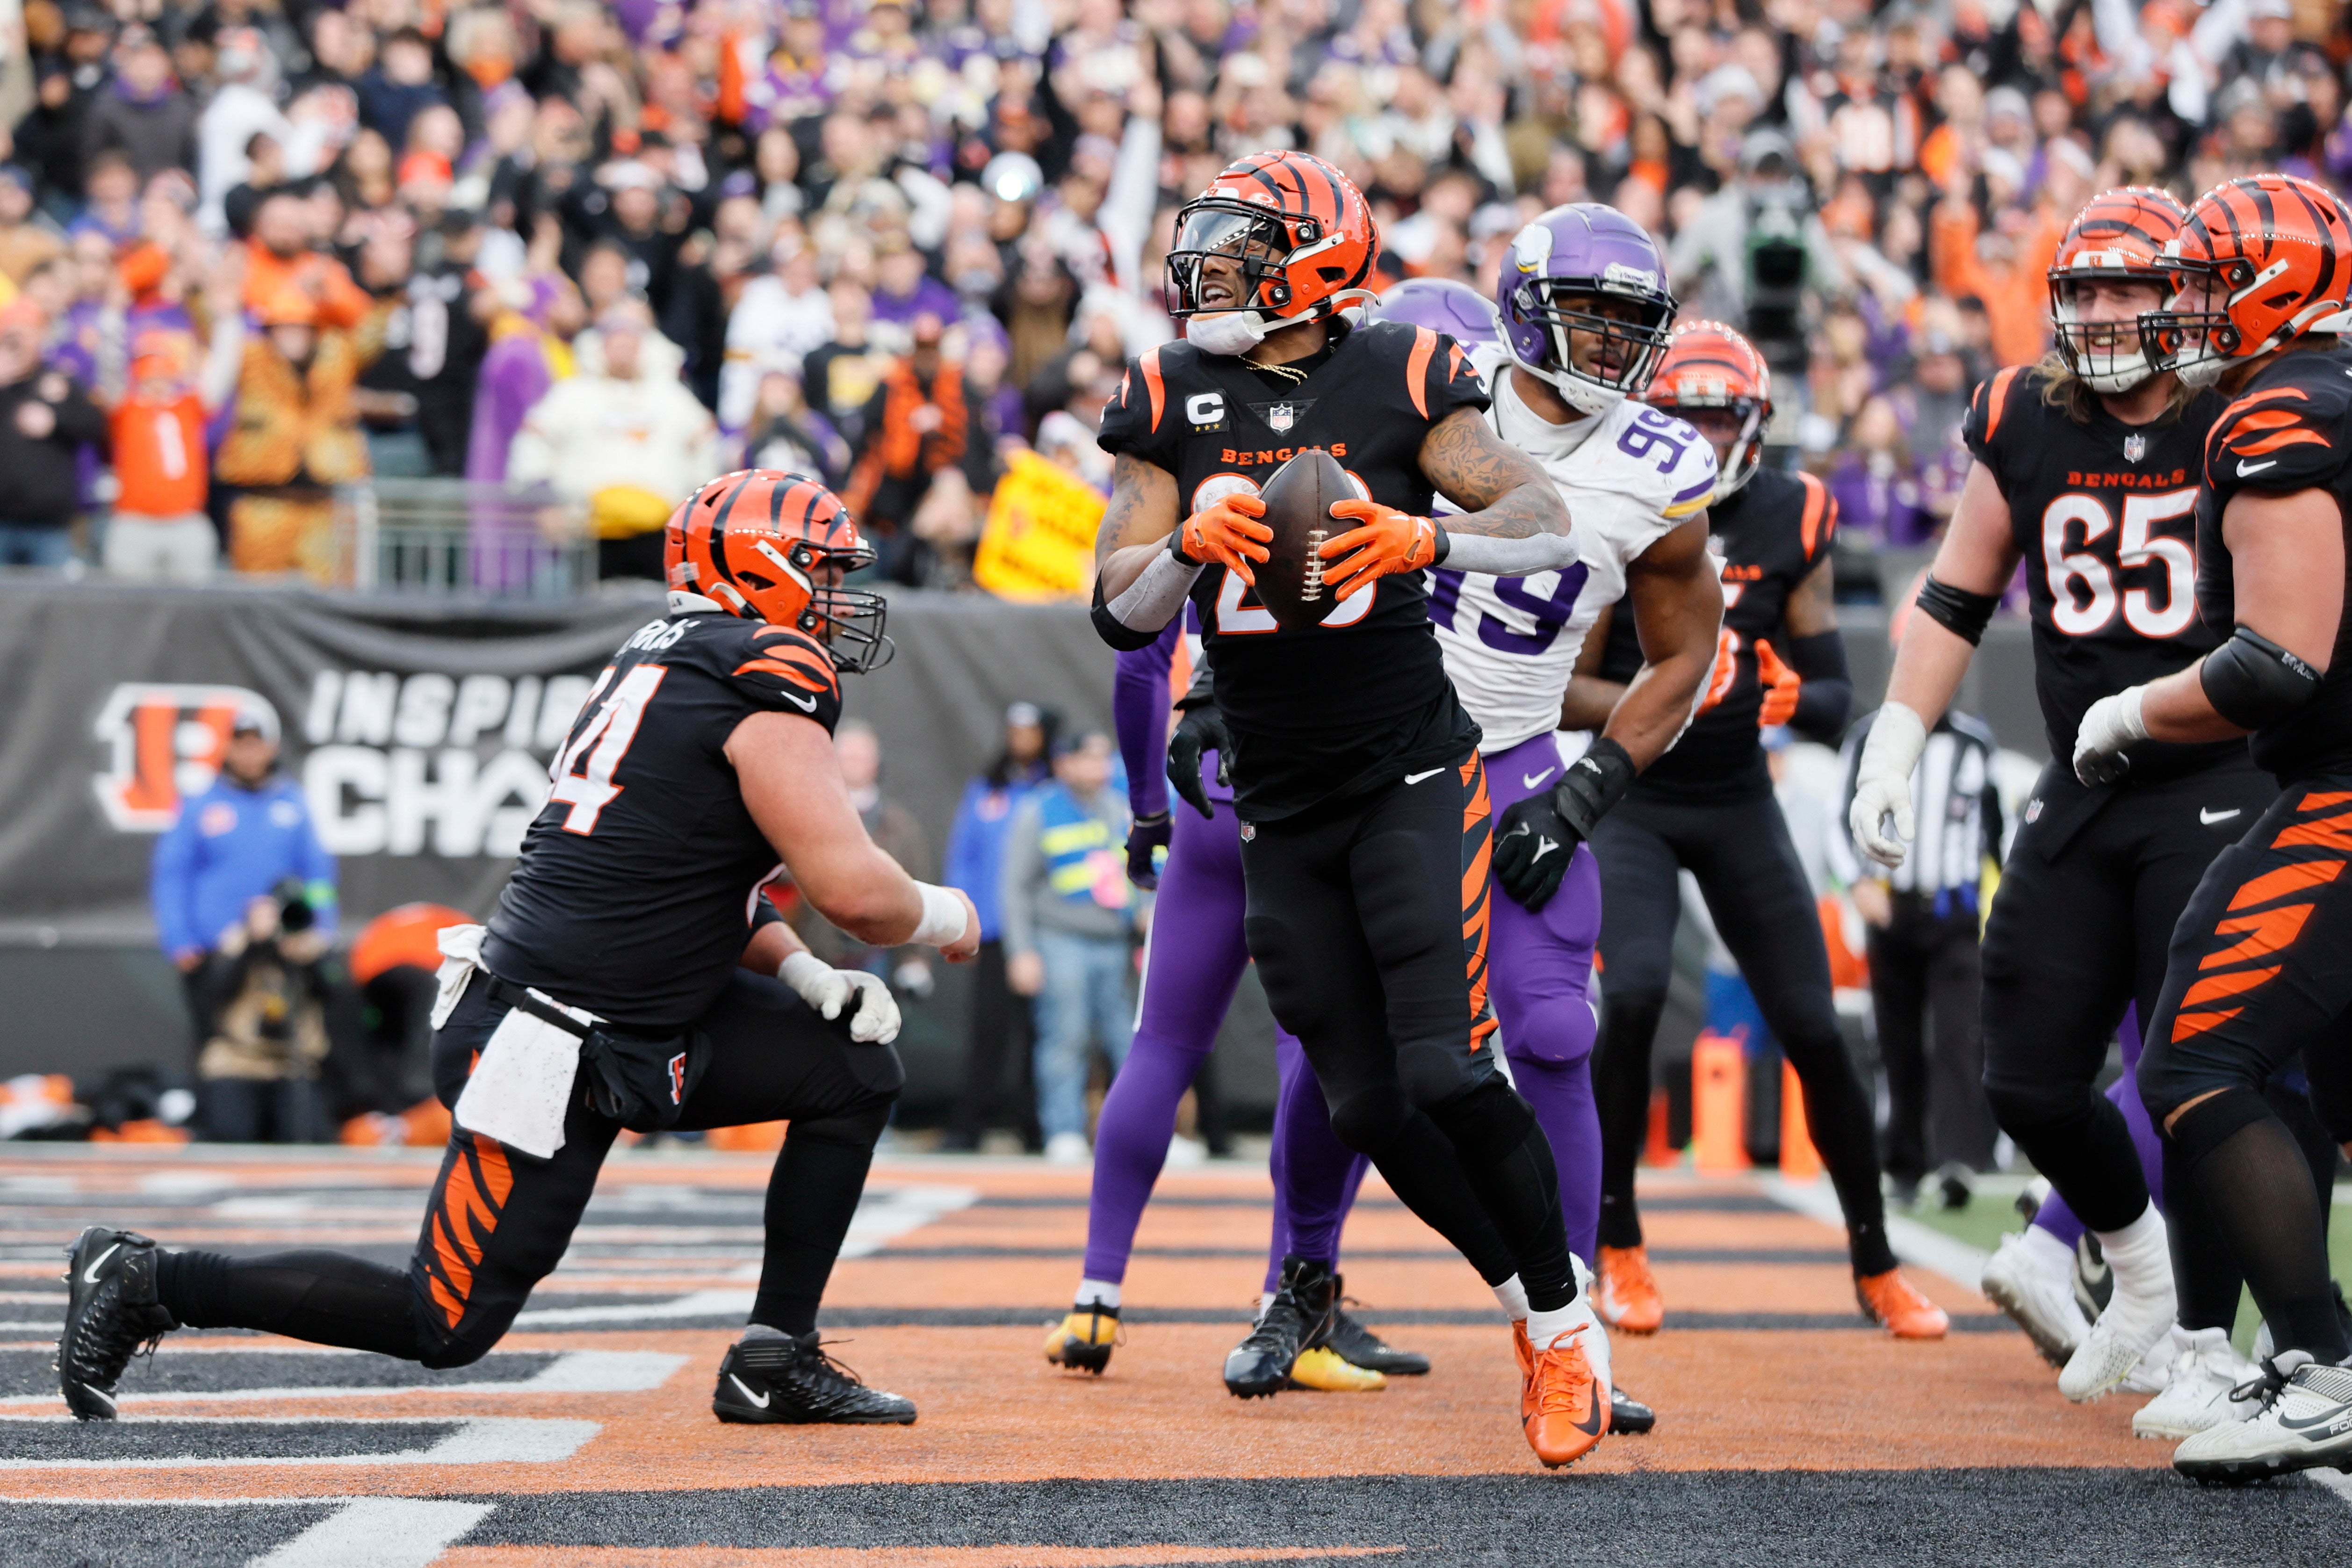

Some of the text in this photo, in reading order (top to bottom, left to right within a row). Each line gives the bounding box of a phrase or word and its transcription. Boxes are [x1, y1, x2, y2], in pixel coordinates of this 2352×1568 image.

[1187, 393, 1224, 425] C
[1617, 410, 1699, 474] 99
[2066, 469, 2186, 488] BENGALS
[2042, 485, 2200, 639] 65
